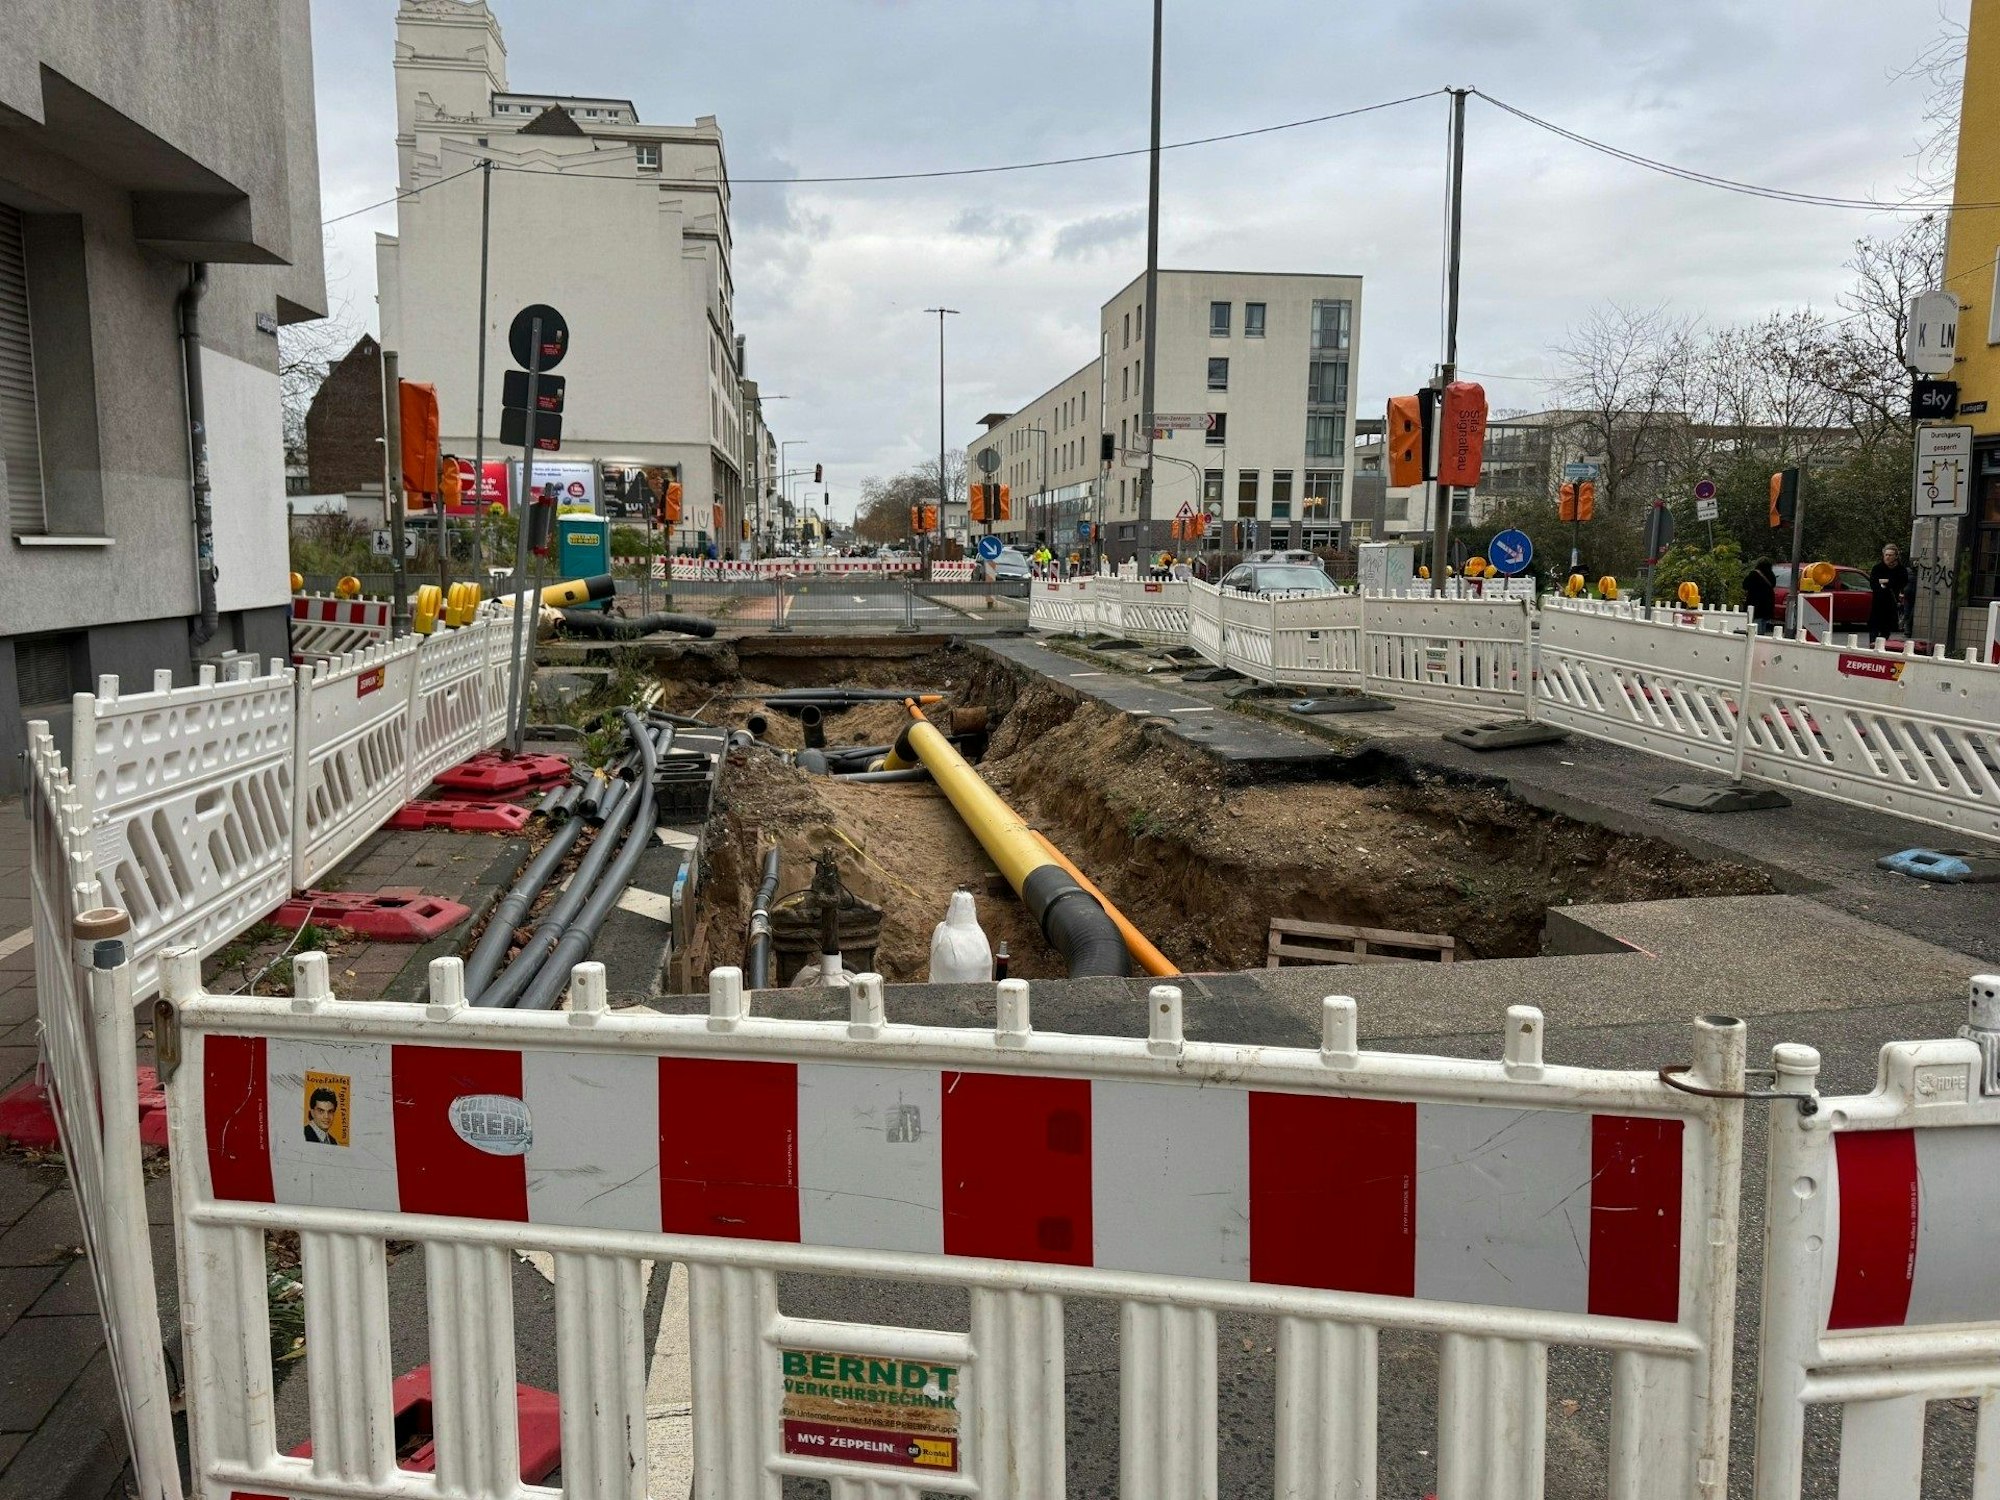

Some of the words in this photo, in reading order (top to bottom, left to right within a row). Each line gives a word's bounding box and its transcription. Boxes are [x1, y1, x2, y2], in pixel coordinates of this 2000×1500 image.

[1922, 389, 1952, 410] sky
[1470, 410, 1480, 433] Sila
[1456, 410, 1470, 471] Signalbau
[1933, 444, 1957, 452] gesperrt
[1846, 660, 1886, 673] ZEPPELIN
[783, 1352, 958, 1392] BERNDT
[783, 1379, 957, 1410] VERKEHRSTECHNIK
[783, 1407, 796, 1417] Ein
[798, 1410, 849, 1423] Unternehmen
[850, 1416, 864, 1425] der
[797, 1433, 825, 1446] MVS
[830, 1437, 895, 1454] ZEPPELIN
[922, 1448, 950, 1458] Rental
